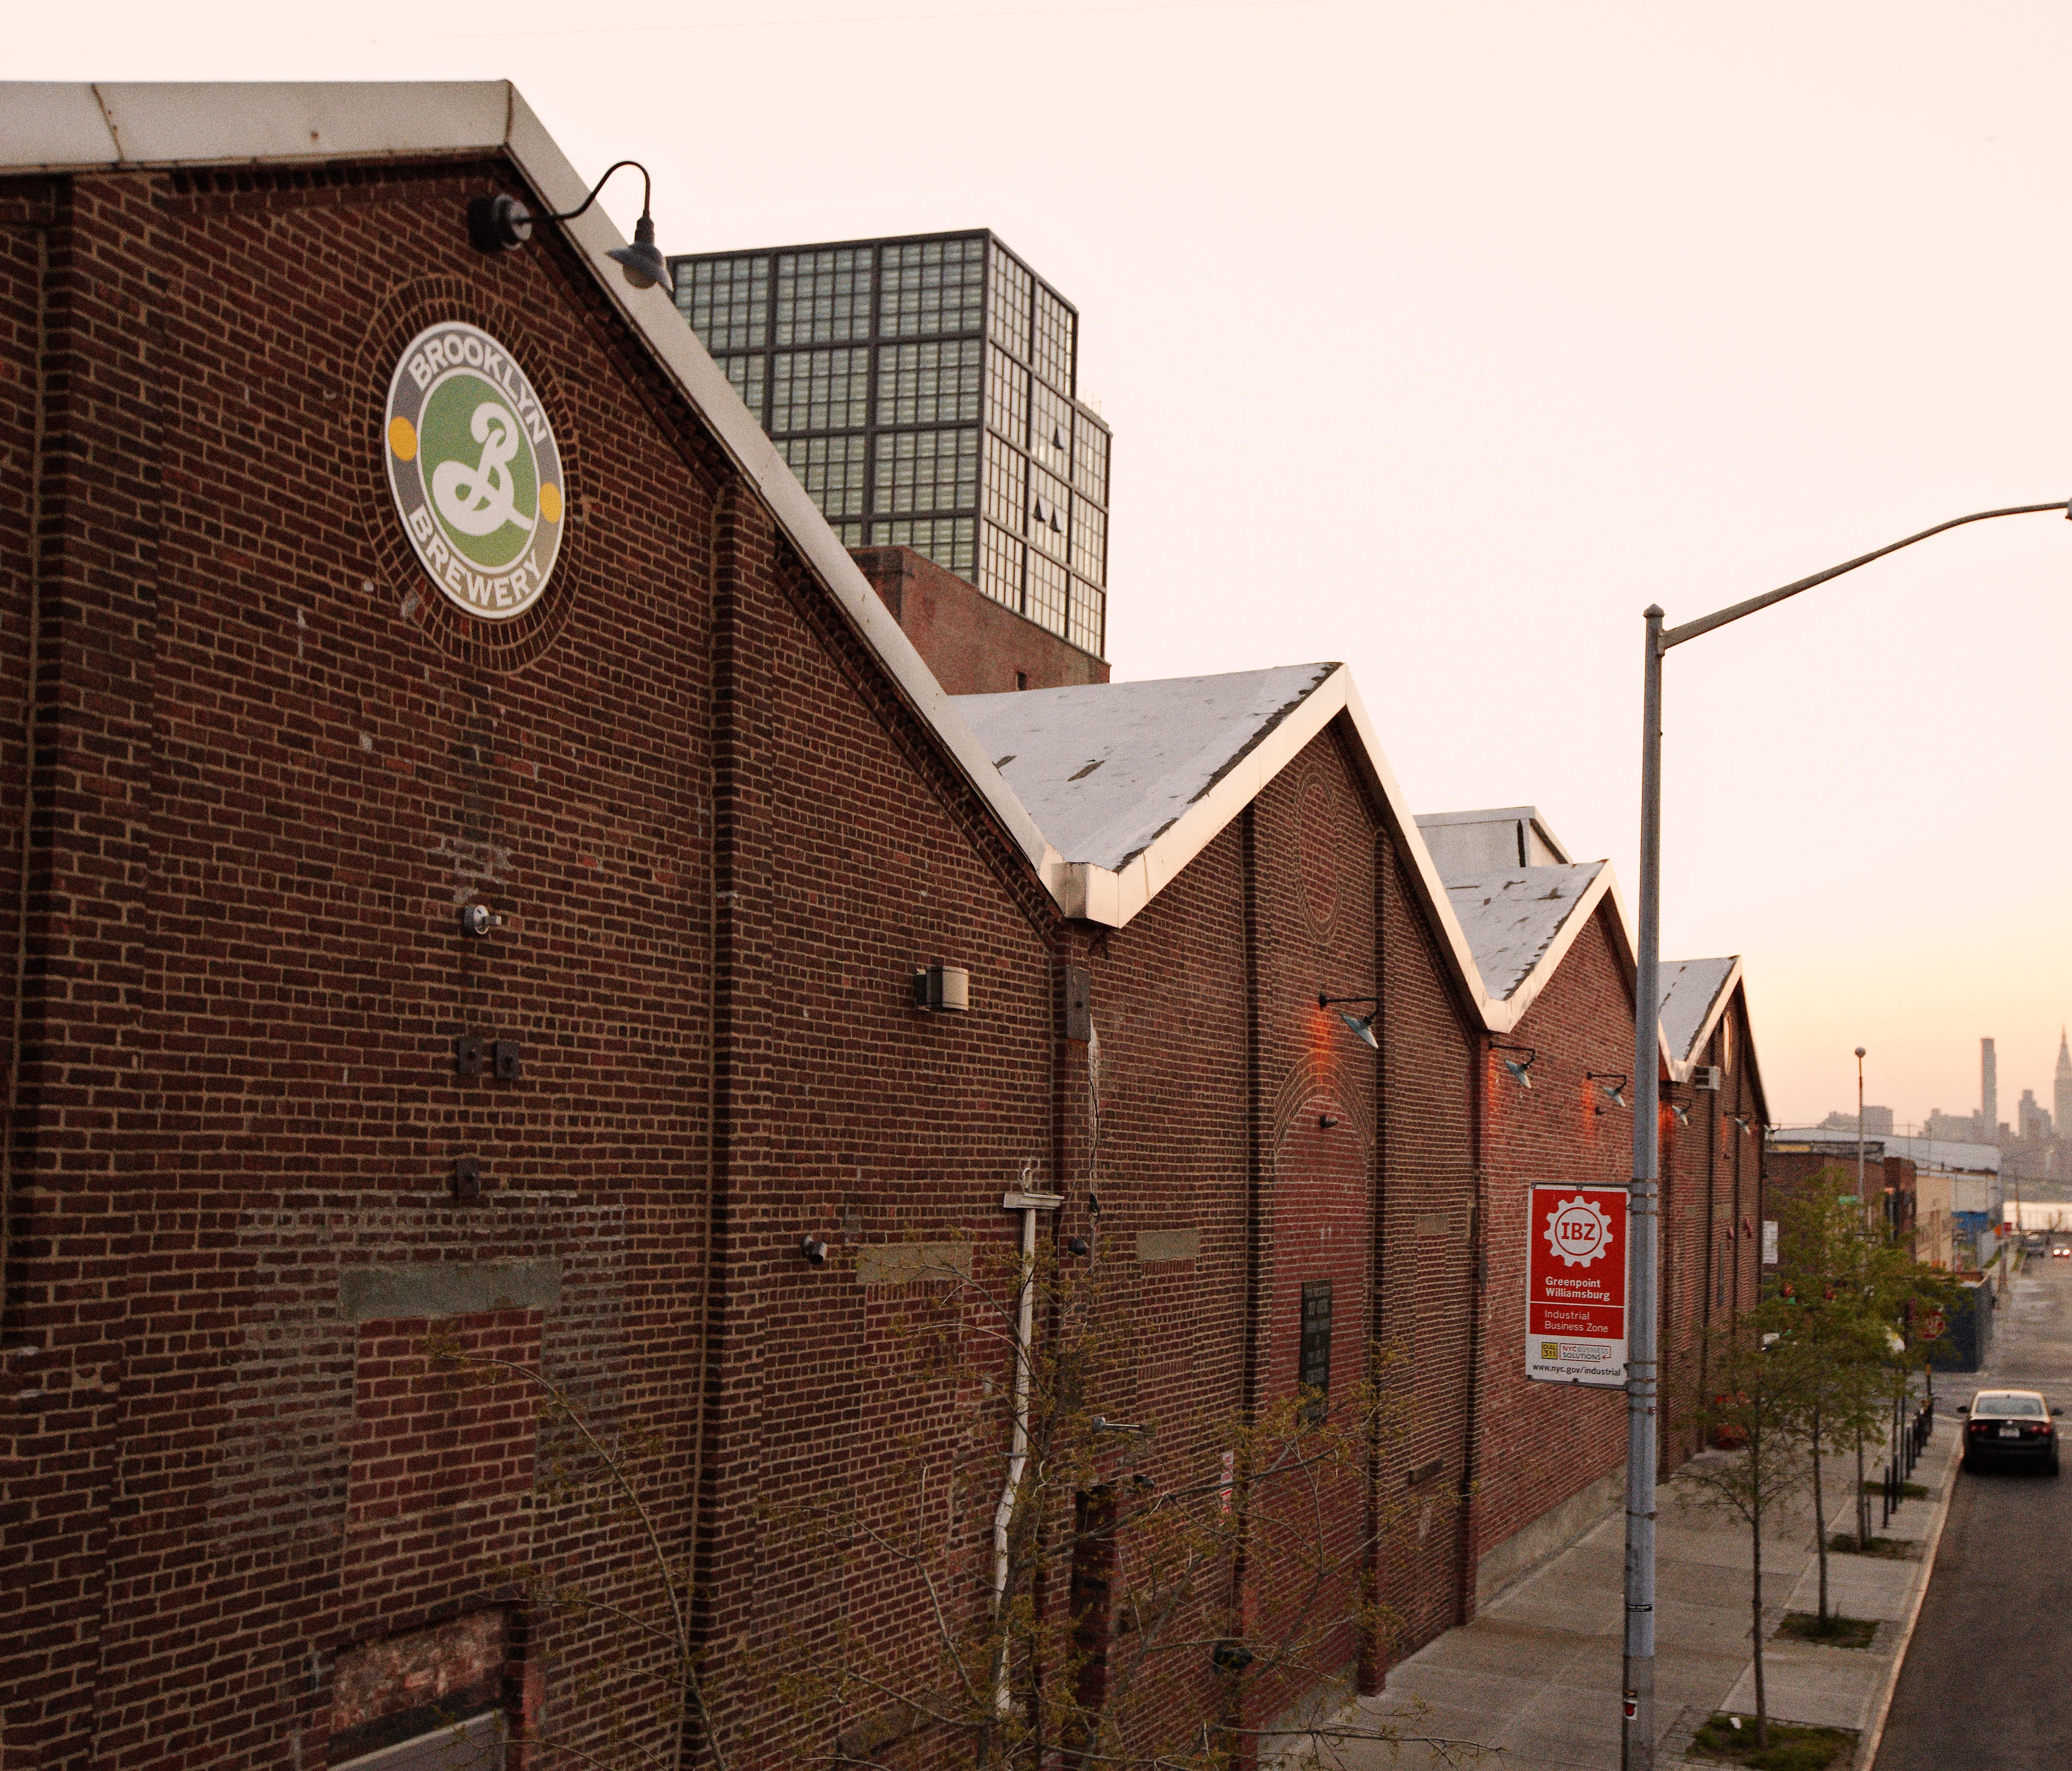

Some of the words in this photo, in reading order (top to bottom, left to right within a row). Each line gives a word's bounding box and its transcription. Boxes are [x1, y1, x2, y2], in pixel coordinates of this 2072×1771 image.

[407, 334, 548, 445] BROOKLYN
[408, 504, 542, 608] BREWERY
[1561, 1222, 1595, 1241] IBZ
[1545, 1276, 1601, 1289] Greenpoint
[1546, 1287, 1610, 1302] Williamsburg
[1545, 1310, 1590, 1320] Industrial
[1545, 1320, 1583, 1331] Business
[1586, 1323, 1608, 1333] Zone
[1563, 1352, 1601, 1360] SOLUTIONS
[1532, 1364, 1621, 1376] www.nyc.gov/industrial
